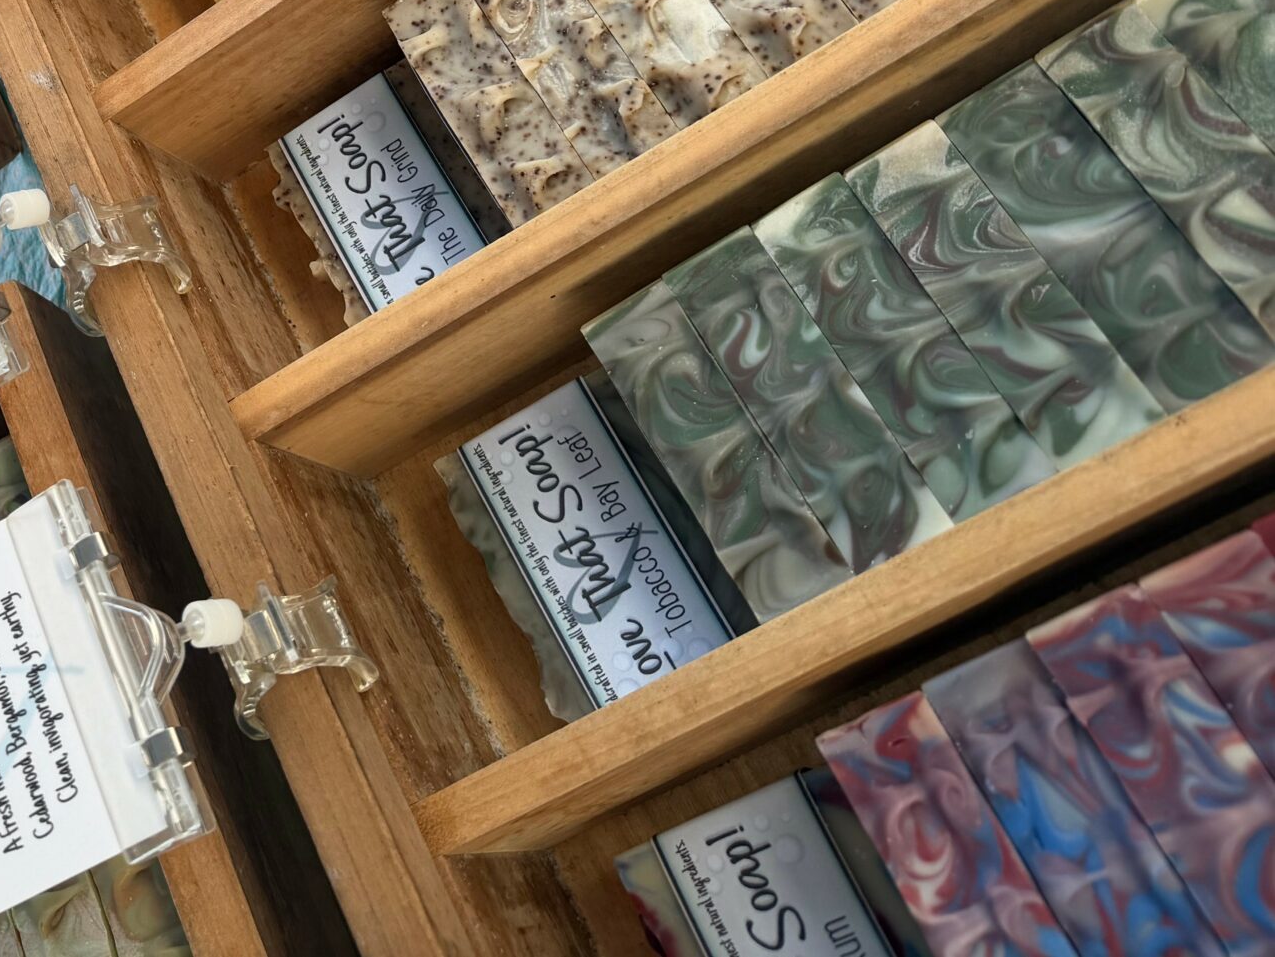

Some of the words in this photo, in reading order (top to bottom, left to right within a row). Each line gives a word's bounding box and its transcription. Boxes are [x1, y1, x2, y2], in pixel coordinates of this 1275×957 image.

[296, 134, 321, 169] ingredients.
[317, 114, 386, 194] Soap!
[380, 138, 418, 183] Grind
[310, 168, 332, 193] natural
[326, 193, 343, 214] finest
[337, 211, 349, 225] the
[407, 183, 445, 228] Daily
[342, 221, 357, 238] only
[350, 238, 366, 254] with
[362, 194, 426, 272] That
[438, 227, 466, 265] The
[361, 253, 380, 282] batches
[371, 278, 391, 300] small
[473, 443, 503, 489] ingredients.
[498, 424, 583, 523] Soap!
[557, 431, 602, 480] Leaf
[492, 486, 518, 518] natural
[592, 481, 627, 522] Bay
[511, 518, 531, 545] finest
[525, 542, 539, 559] the
[610, 522, 641, 543] &
[532, 555, 550, 576] only
[556, 526, 632, 622] That
[542, 576, 560, 596] with
[626, 546, 692, 638] Tobacco
[0, 591, 24, 639] earthy.
[555, 595, 580, 631] batches
[13, 642, 41, 664] yet
[569, 628, 592, 654] small
[26, 663, 64, 752] invigorating,
[13, 752, 54, 839] Cedarwood,
[55, 753, 78, 803] Clean,
[675, 839, 711, 898] ingredients.
[705, 825, 807, 951] Soap!
[697, 897, 728, 937] natural
